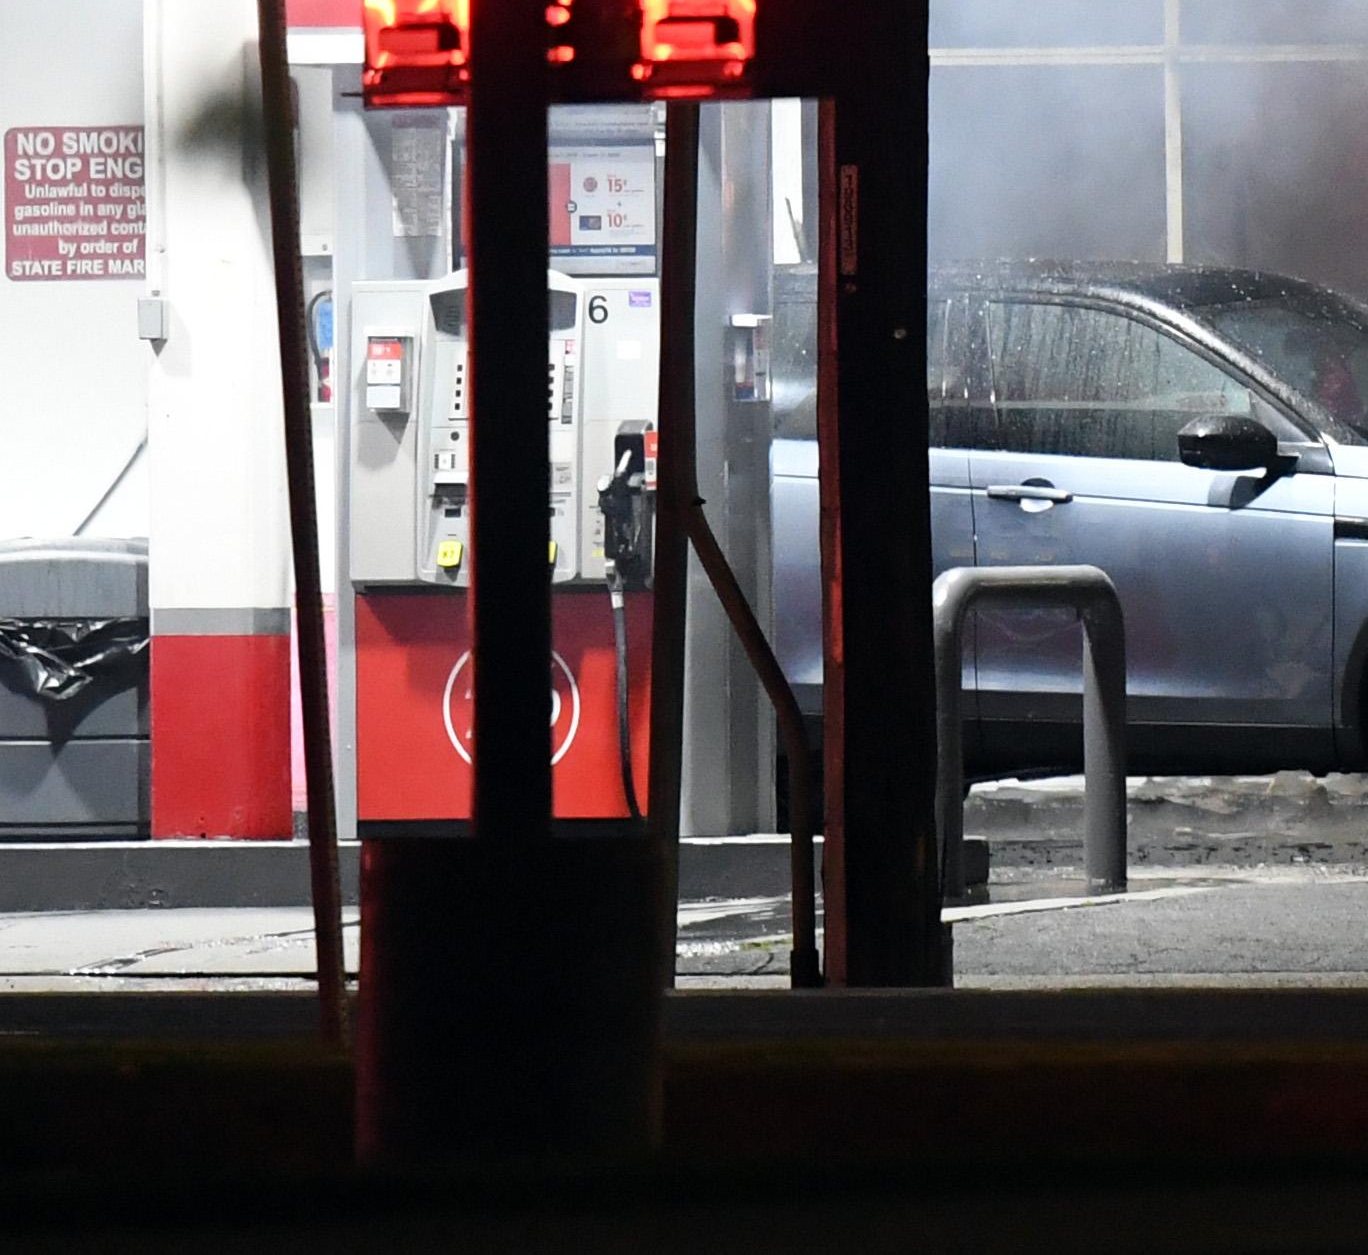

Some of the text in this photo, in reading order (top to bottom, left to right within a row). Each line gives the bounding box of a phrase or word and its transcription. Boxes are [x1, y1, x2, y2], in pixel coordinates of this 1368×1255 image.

[17, 132, 143, 156] NO SMOKI
[15, 157, 143, 180] STOP ENG
[25, 183, 87, 199] Unlawful
[91, 184, 106, 197] to
[15, 202, 76, 220] gasoline
[80, 201, 94, 216] in
[97, 204, 123, 219] any
[13, 221, 146, 236] unauthorized cont
[58, 238, 139, 257] by order of
[12, 259, 145, 276] STATE FIRE MAR
[588, 295, 609, 325] 6
